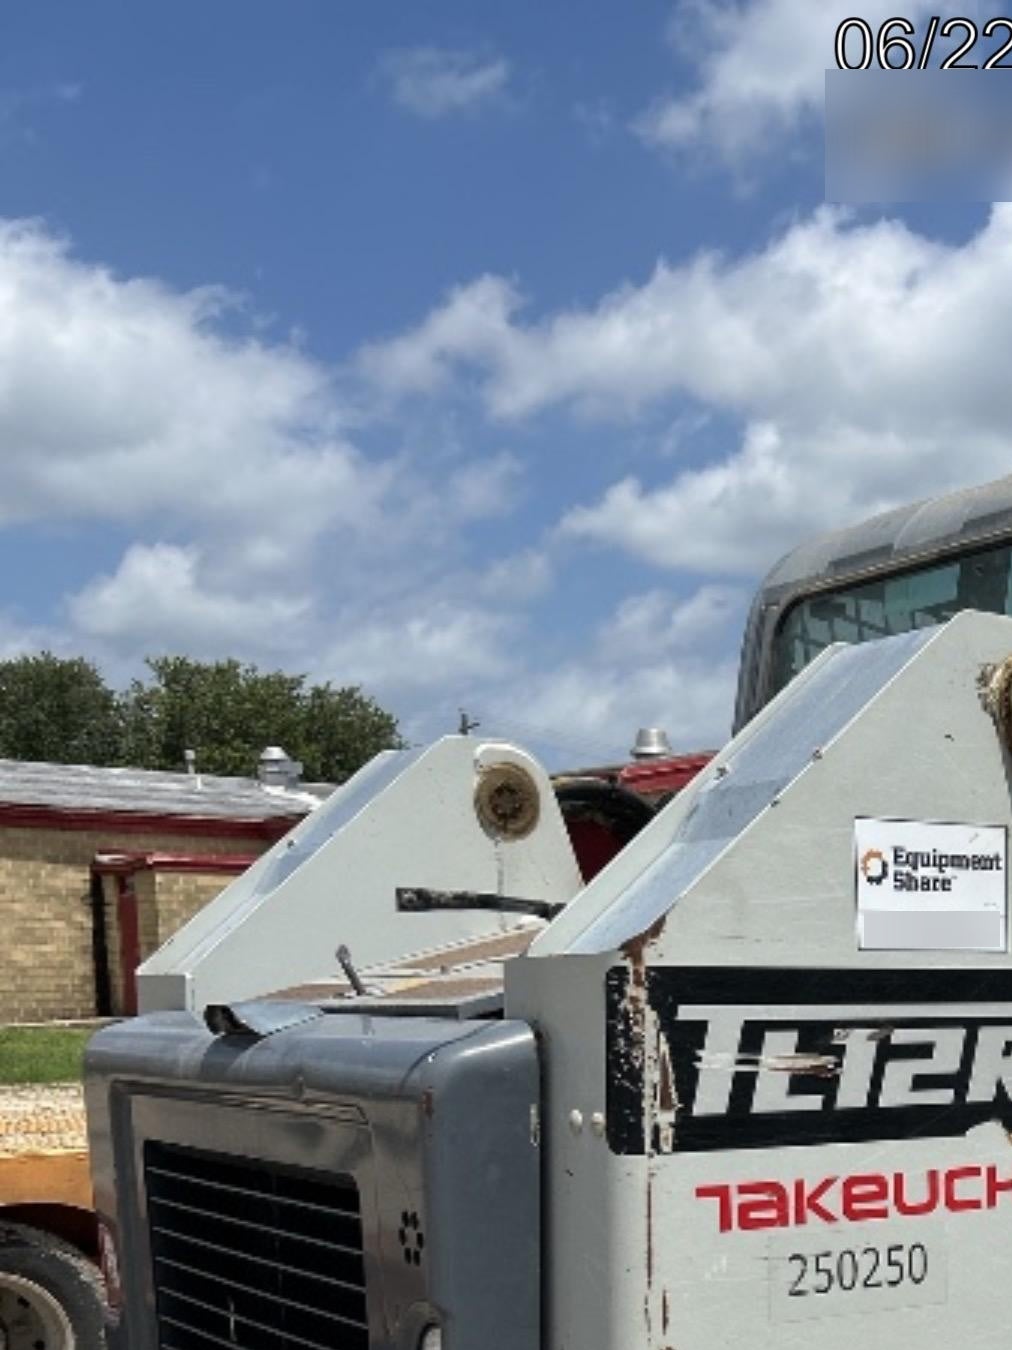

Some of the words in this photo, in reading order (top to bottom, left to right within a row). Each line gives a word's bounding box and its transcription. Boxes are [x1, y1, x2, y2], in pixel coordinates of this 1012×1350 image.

[892, 846, 1002, 873] Equipment
[893, 871, 952, 891] Share
[786, 1243, 929, 1297] 250250
